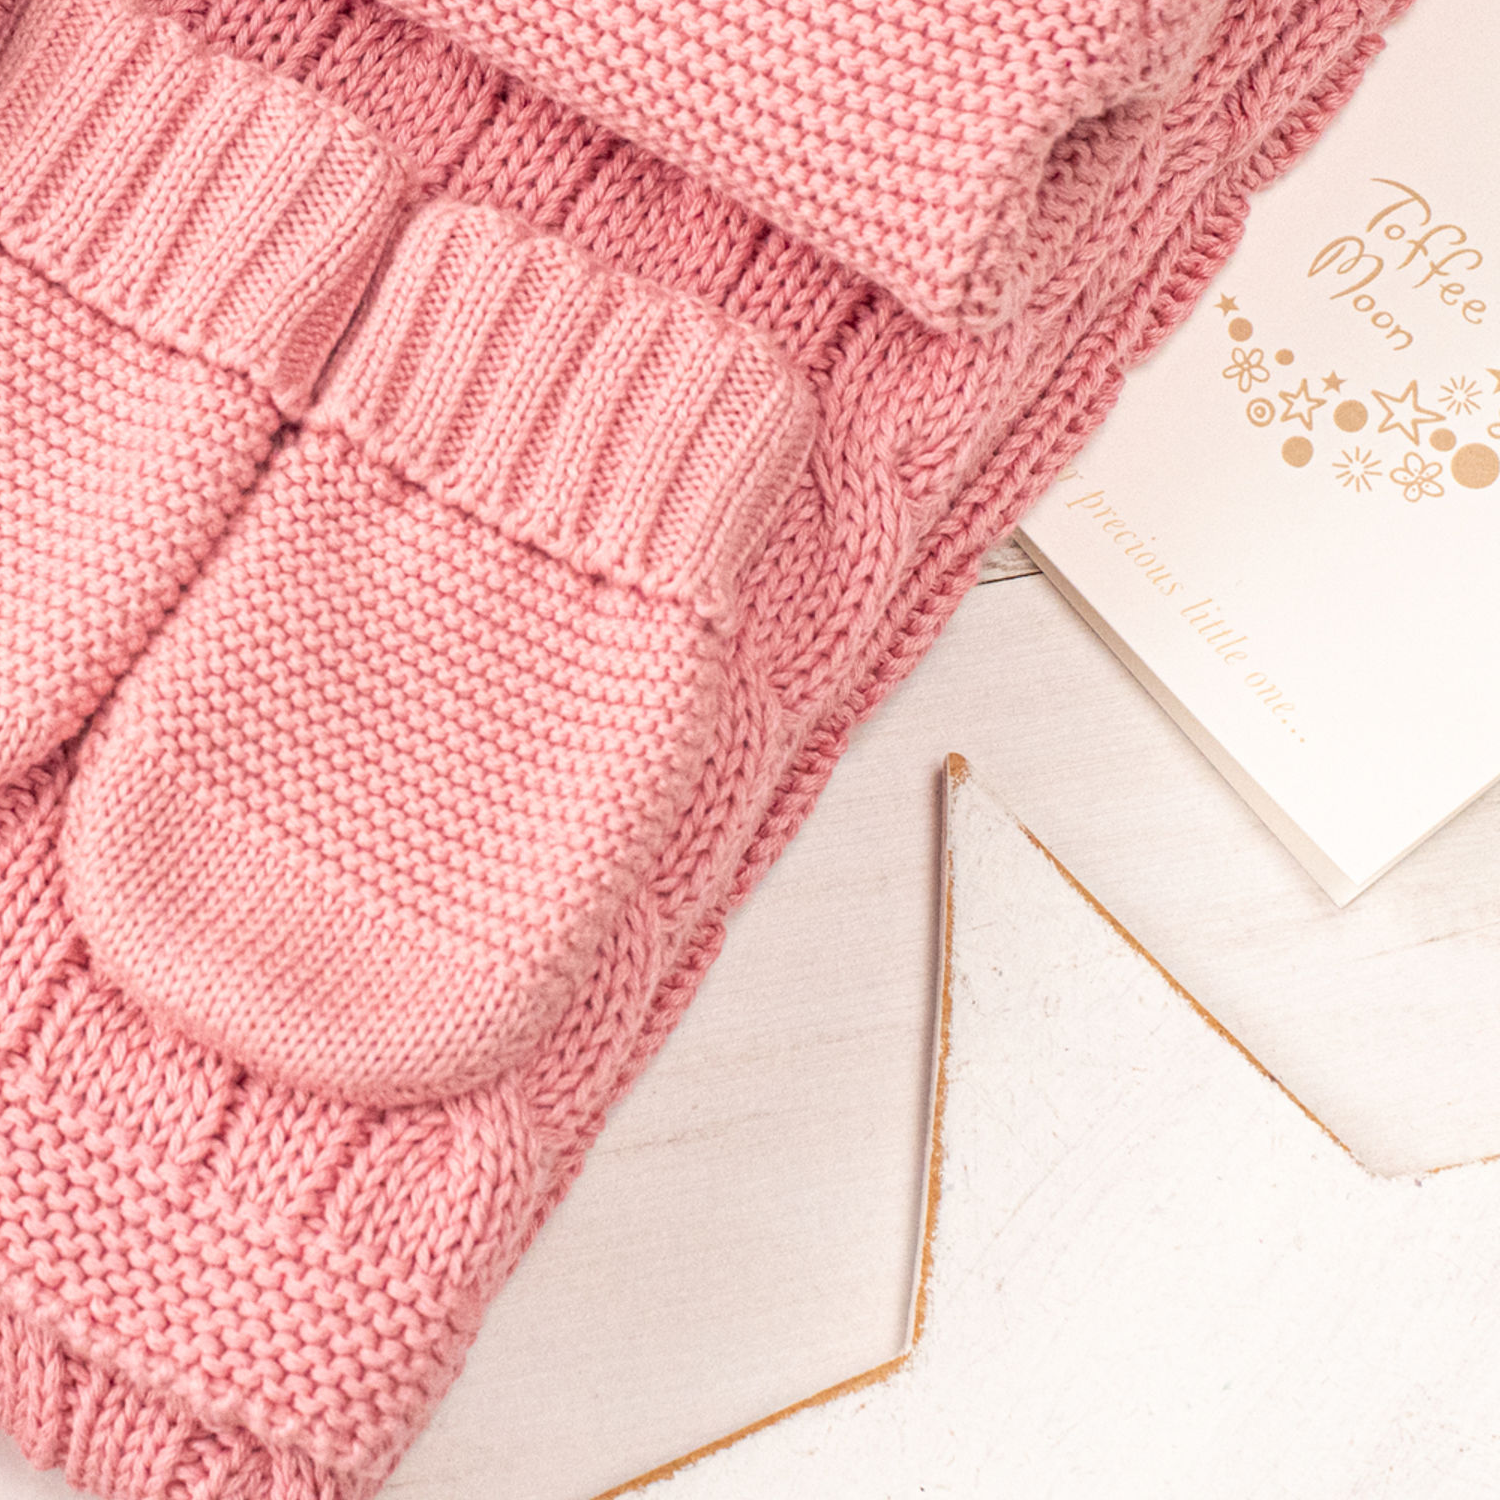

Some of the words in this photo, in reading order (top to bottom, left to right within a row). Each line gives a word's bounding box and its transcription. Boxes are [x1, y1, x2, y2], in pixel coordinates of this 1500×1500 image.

[1307, 235, 1414, 351] Moon
[1365, 177, 1487, 325] Toffee
[1064, 489, 1185, 596] precious
[1179, 597, 1249, 665] little
[1244, 671, 1306, 743] one...
